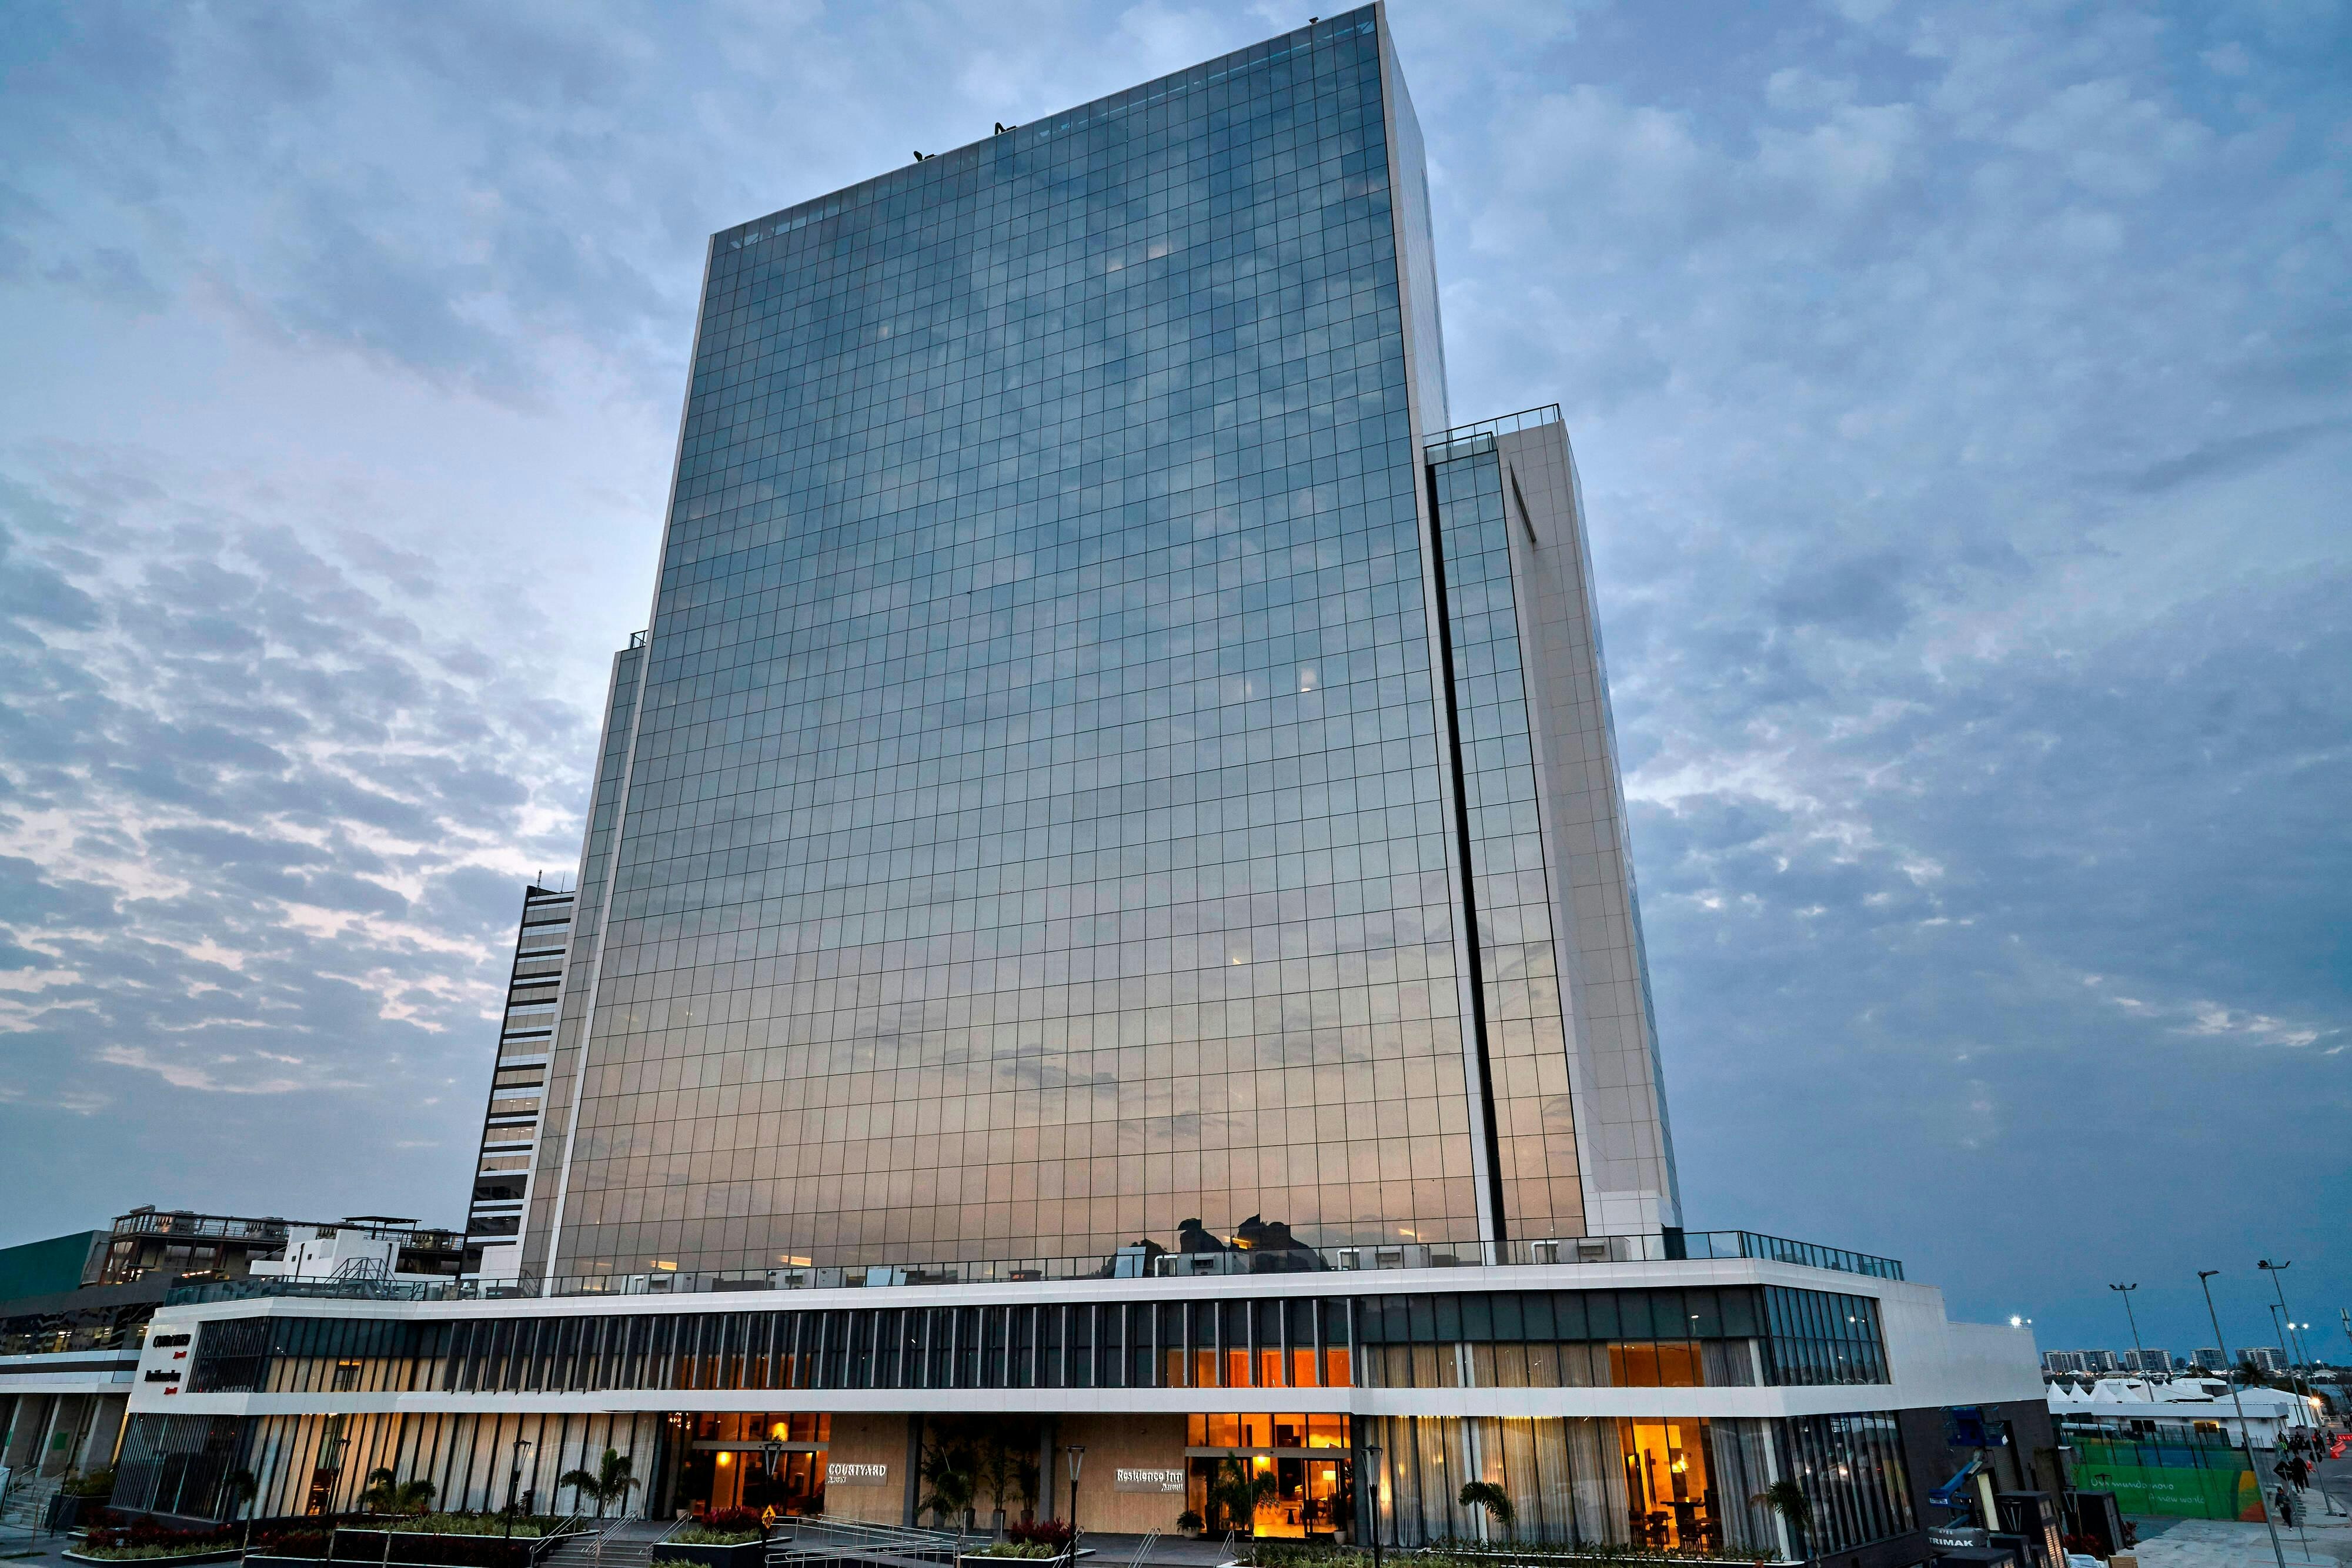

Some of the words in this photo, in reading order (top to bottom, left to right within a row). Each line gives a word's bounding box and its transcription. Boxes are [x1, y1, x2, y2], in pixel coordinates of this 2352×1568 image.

[828, 1464, 886, 1476] COURTYARD
[1117, 1469, 1164, 1482] Residence
[1165, 1470, 1183, 1482] Inn
[2112, 1480, 2148, 1489] mundo
[1929, 1537, 1973, 1547] TRIMAK
